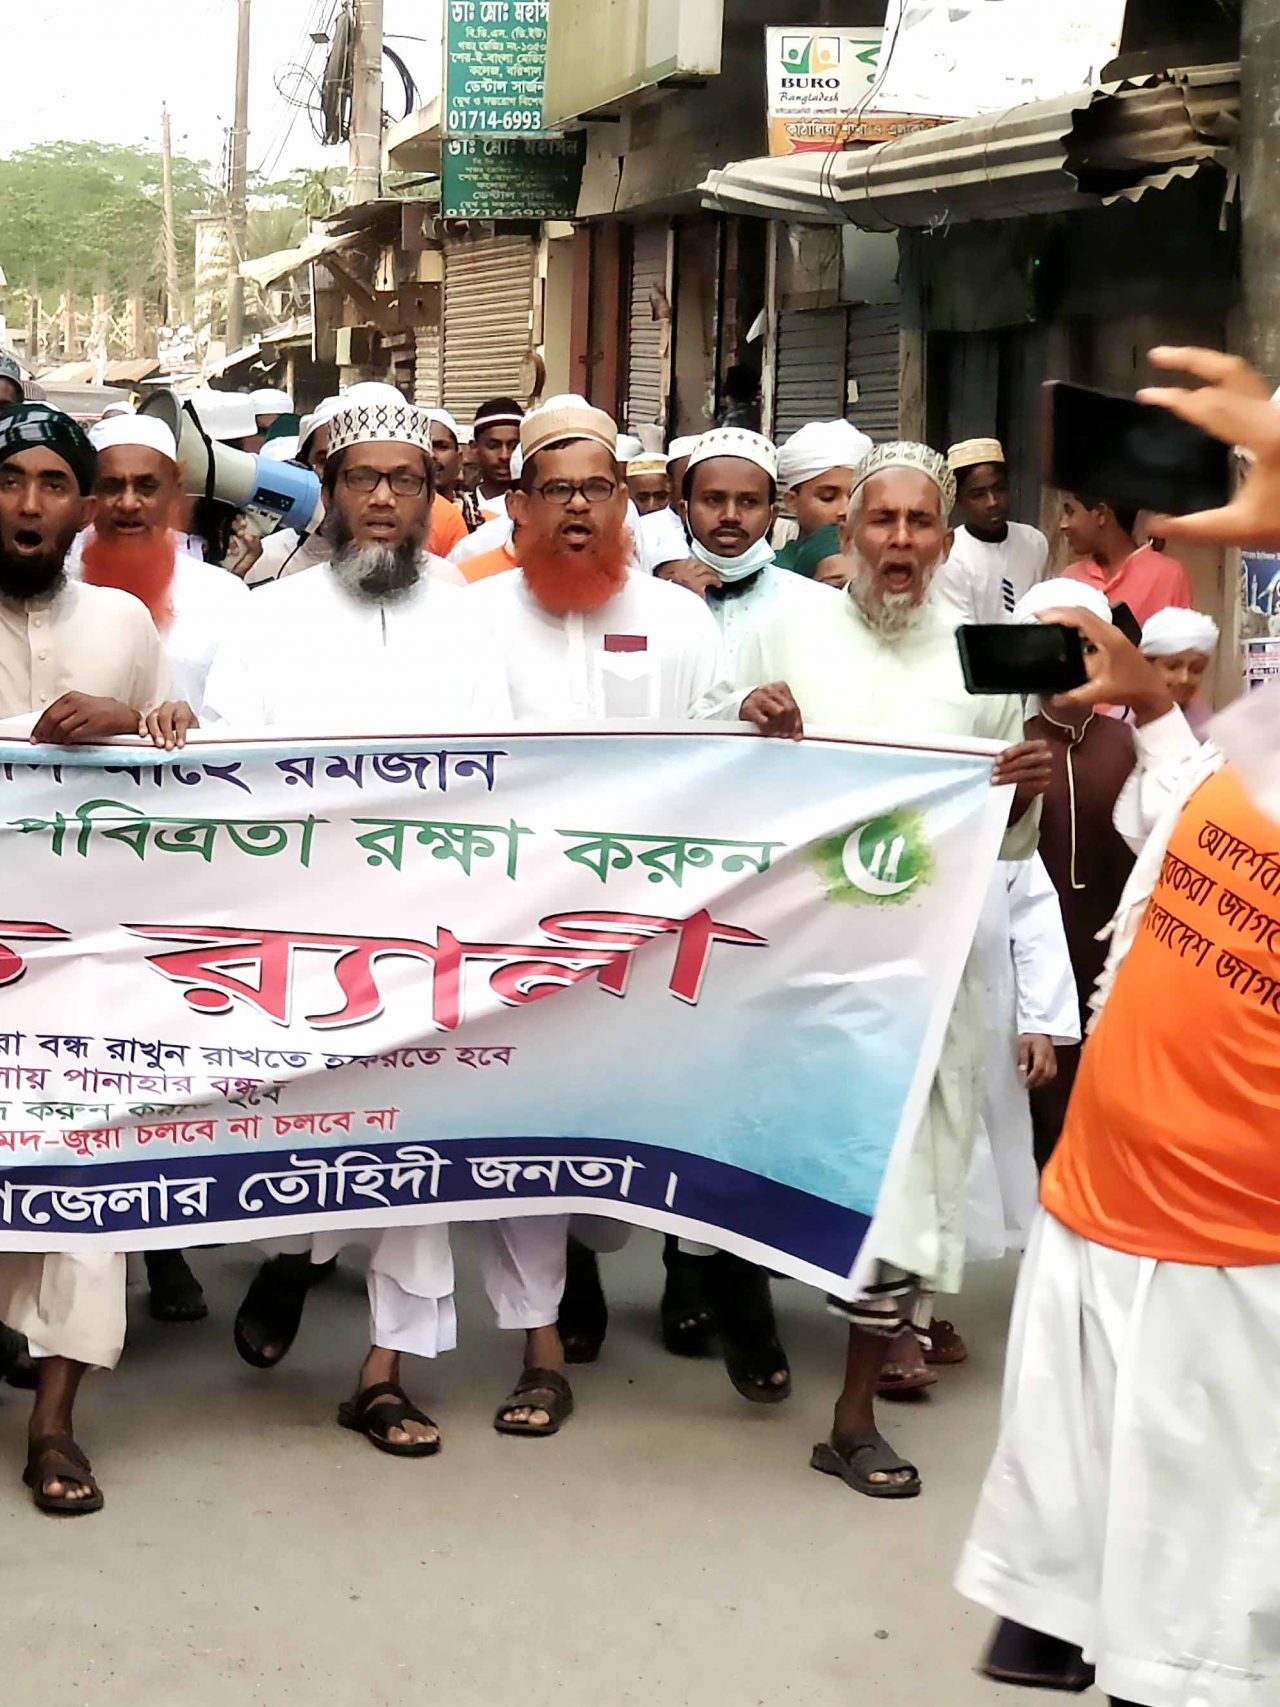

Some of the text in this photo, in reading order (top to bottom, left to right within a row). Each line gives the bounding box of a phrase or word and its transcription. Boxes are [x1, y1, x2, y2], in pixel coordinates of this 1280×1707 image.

[779, 91, 839, 104] Bangladesh
[781, 77, 840, 88] BURO
[449, 110, 541, 130] 01714-6993
[276, 749, 508, 793] রমজান
[10, 799, 332, 868] পবিত্রতা
[351, 817, 536, 880] রক্ষা
[555, 829, 788, 888] করুন
[1160, 851, 1218, 907] বকরা
[35, 1033, 95, 1059] বন্ধ
[104, 1036, 191, 1069] রাখুন
[199, 1046, 312, 1069] রাখতে
[456, 1046, 517, 1070] হবে
[63, 1066, 197, 1095] পানাহার
[207, 1075, 266, 1096] বন্ধ
[134, 1120, 218, 1146] চলবে
[227, 1114, 263, 1141] না
[273, 1110, 356, 1137] চলবে
[365, 1106, 401, 1132] না
[237, 1149, 453, 1213] তৌহিদী
[465, 1152, 648, 1199] জনতা
